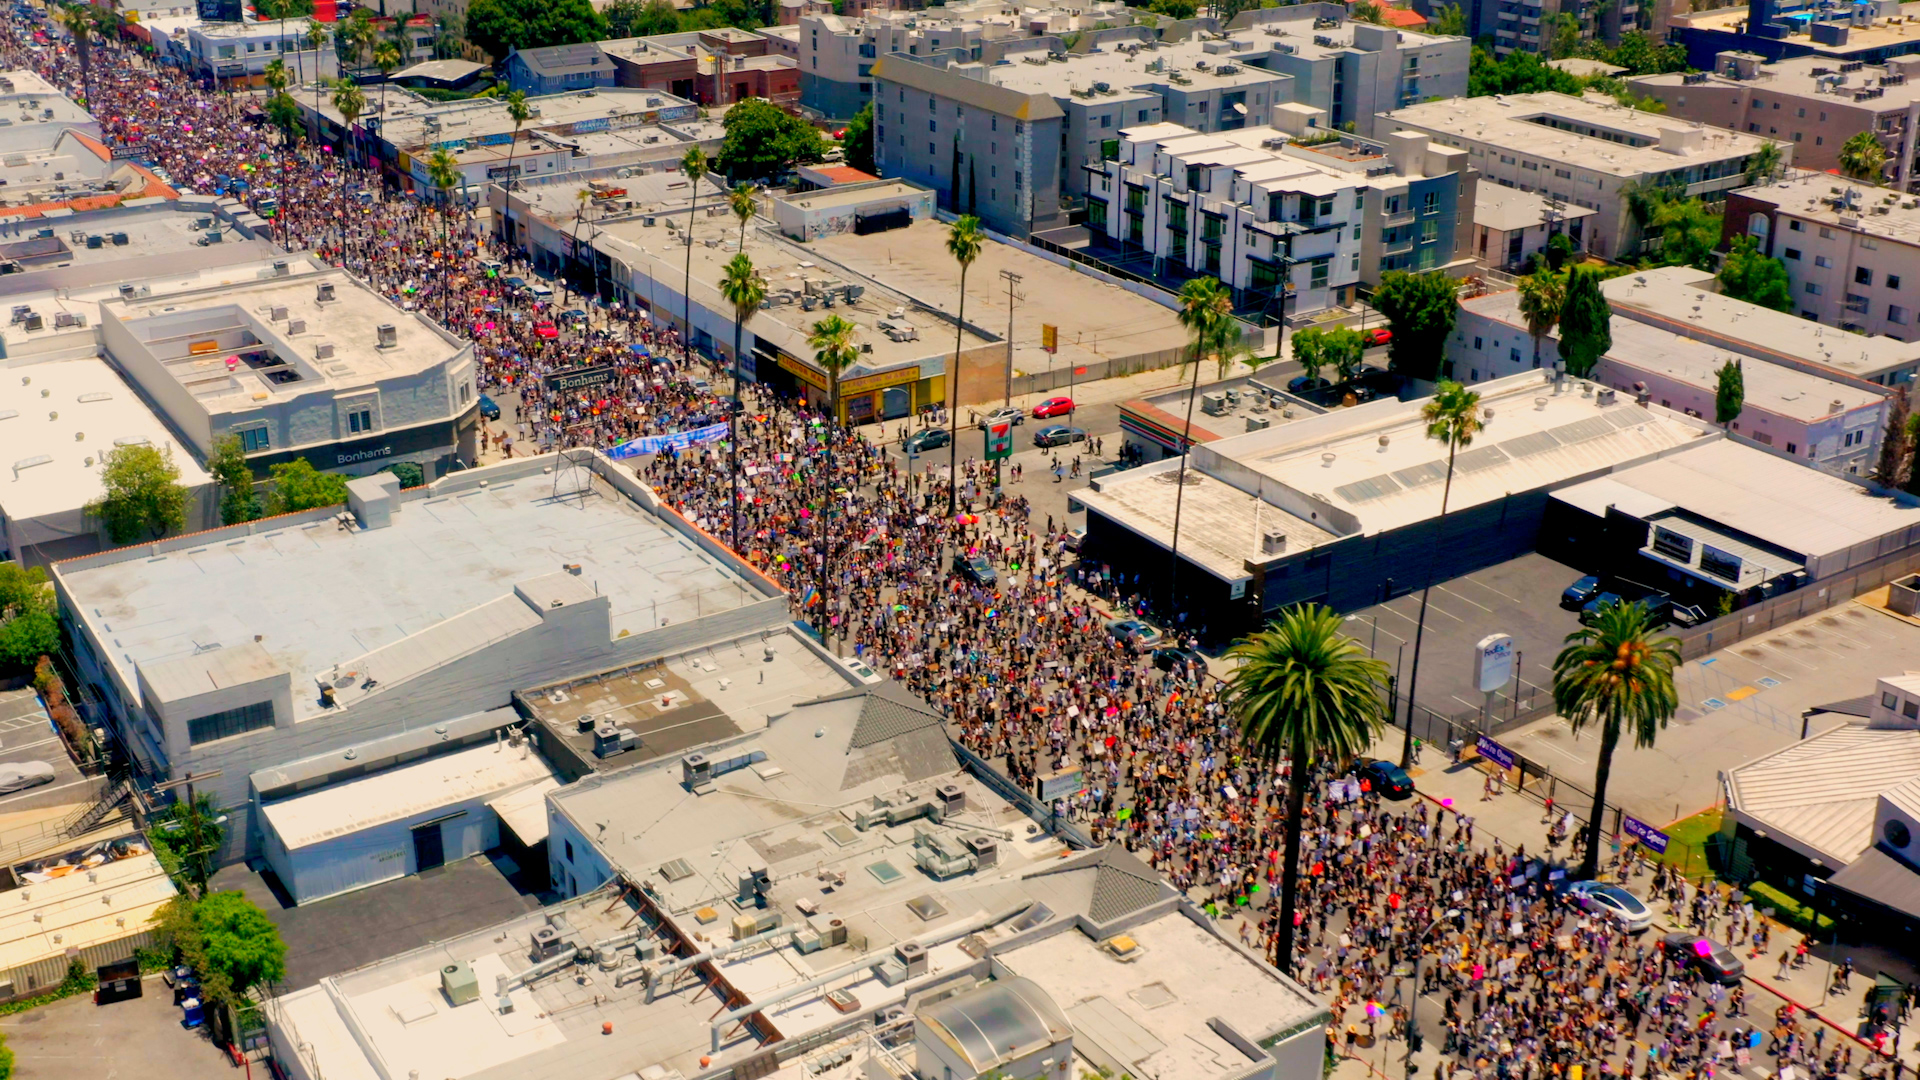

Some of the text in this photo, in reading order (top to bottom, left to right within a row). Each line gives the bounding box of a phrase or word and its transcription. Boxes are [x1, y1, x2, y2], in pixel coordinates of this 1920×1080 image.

[111, 146, 148, 156] CHEEBO
[782, 355, 809, 376] LIQUOR
[559, 372, 609, 390] Bonhams
[847, 375, 883, 389] LIQUOR
[885, 369, 911, 381] MART
[337, 446, 392, 464] Bonhams
[1484, 644, 1504, 657] FedEx
[1494, 651, 1511, 660] Office
[1476, 737, 1497, 755] We're
[1496, 748, 1513, 764] Open
[1625, 818, 1647, 836] We're
[1646, 829, 1667, 847] Open
